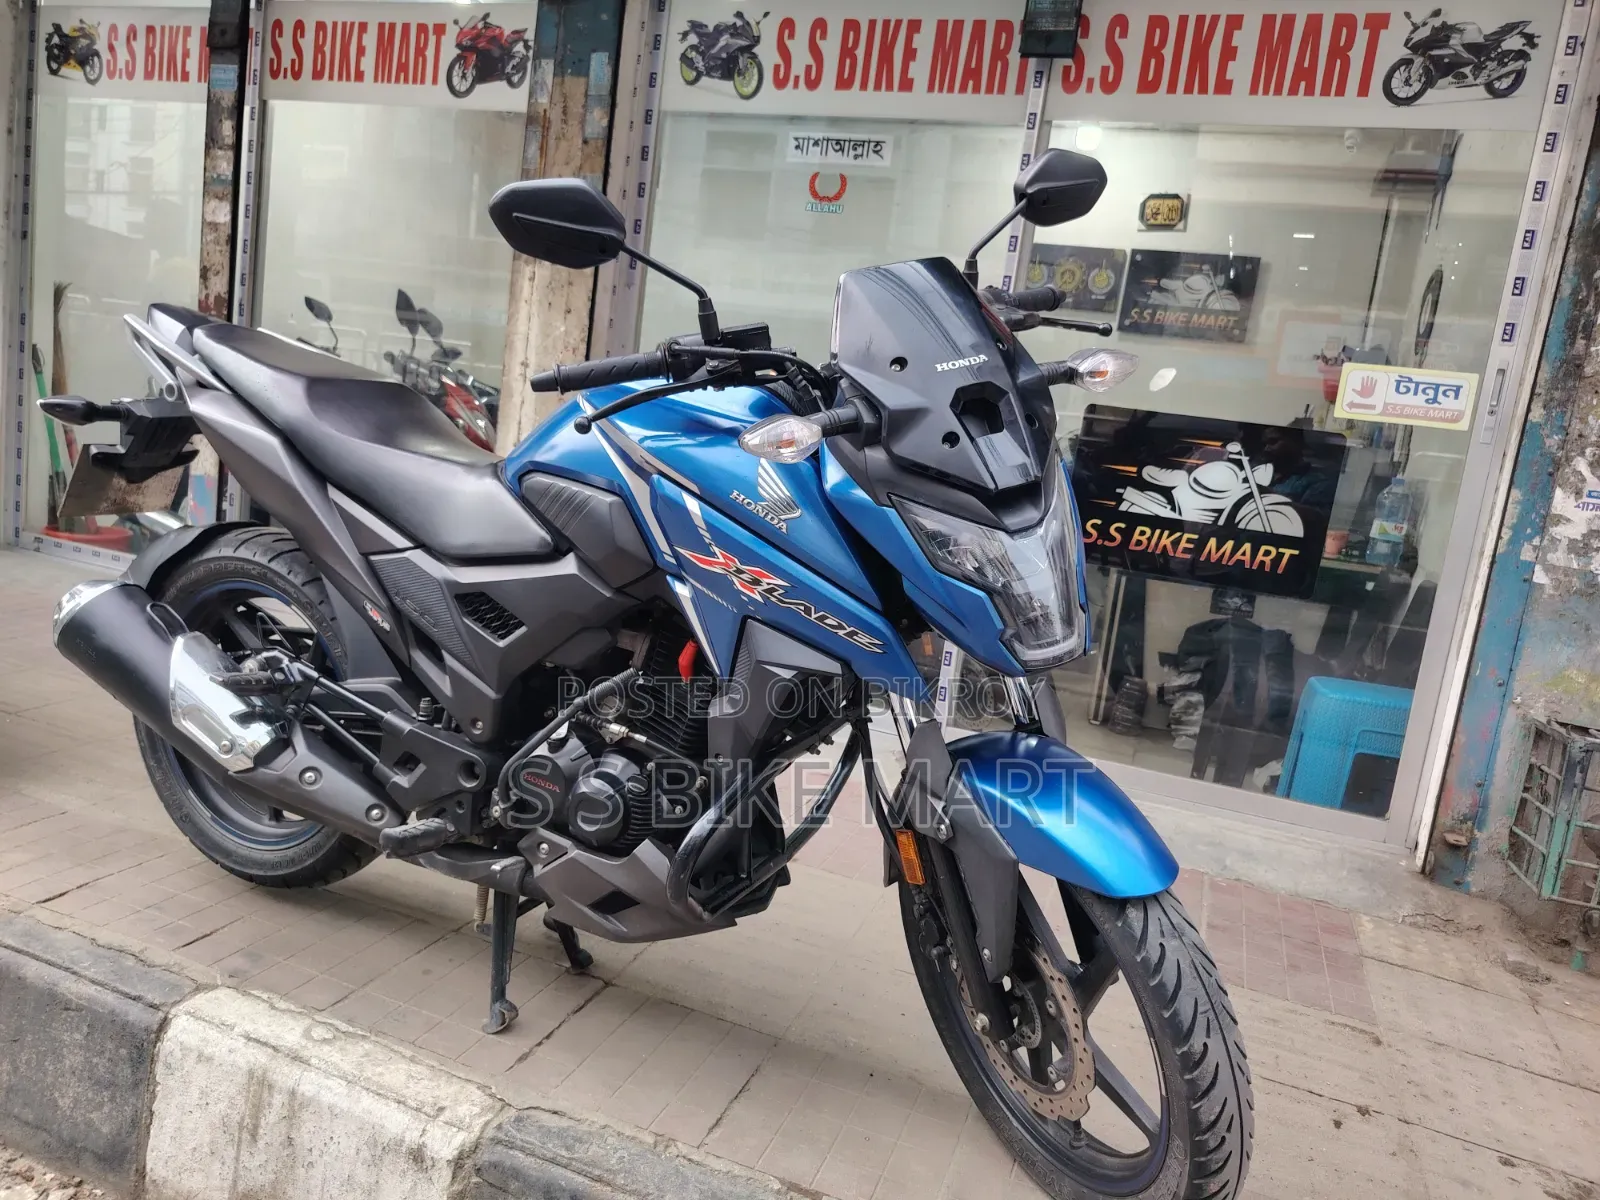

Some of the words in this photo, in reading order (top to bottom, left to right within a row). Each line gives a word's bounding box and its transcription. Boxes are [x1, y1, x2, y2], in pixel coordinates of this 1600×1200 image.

[106, 23, 138, 82] S.S
[143, 24, 191, 83] BIKE
[269, 18, 305, 82] S.S
[312, 20, 368, 84] BIKE
[373, 22, 447, 87] MART
[772, 16, 828, 92] S.S
[834, 18, 922, 94] BIKE
[1061, 13, 1130, 95] S.S
[1136, 13, 1244, 97] BIKE
[1249, 12, 1392, 99] MART
[793, 136, 887, 161] মাশাআল্লাহ
[805, 201, 845, 214] ALLAHU
[1154, 310, 1189, 327] BIKE
[1190, 313, 1239, 331] MART
[935, 354, 989, 372] HONDA
[1395, 375, 1463, 406] টানুন
[1402, 406, 1425, 417] BIKE
[1426, 410, 1459, 420] MART
[729, 489, 788, 535] HONDA
[1082, 517, 1127, 548] S.S
[1128, 525, 1200, 559] BIKE
[1199, 536, 1300, 574] MART
[523, 773, 561, 793] HONDA
